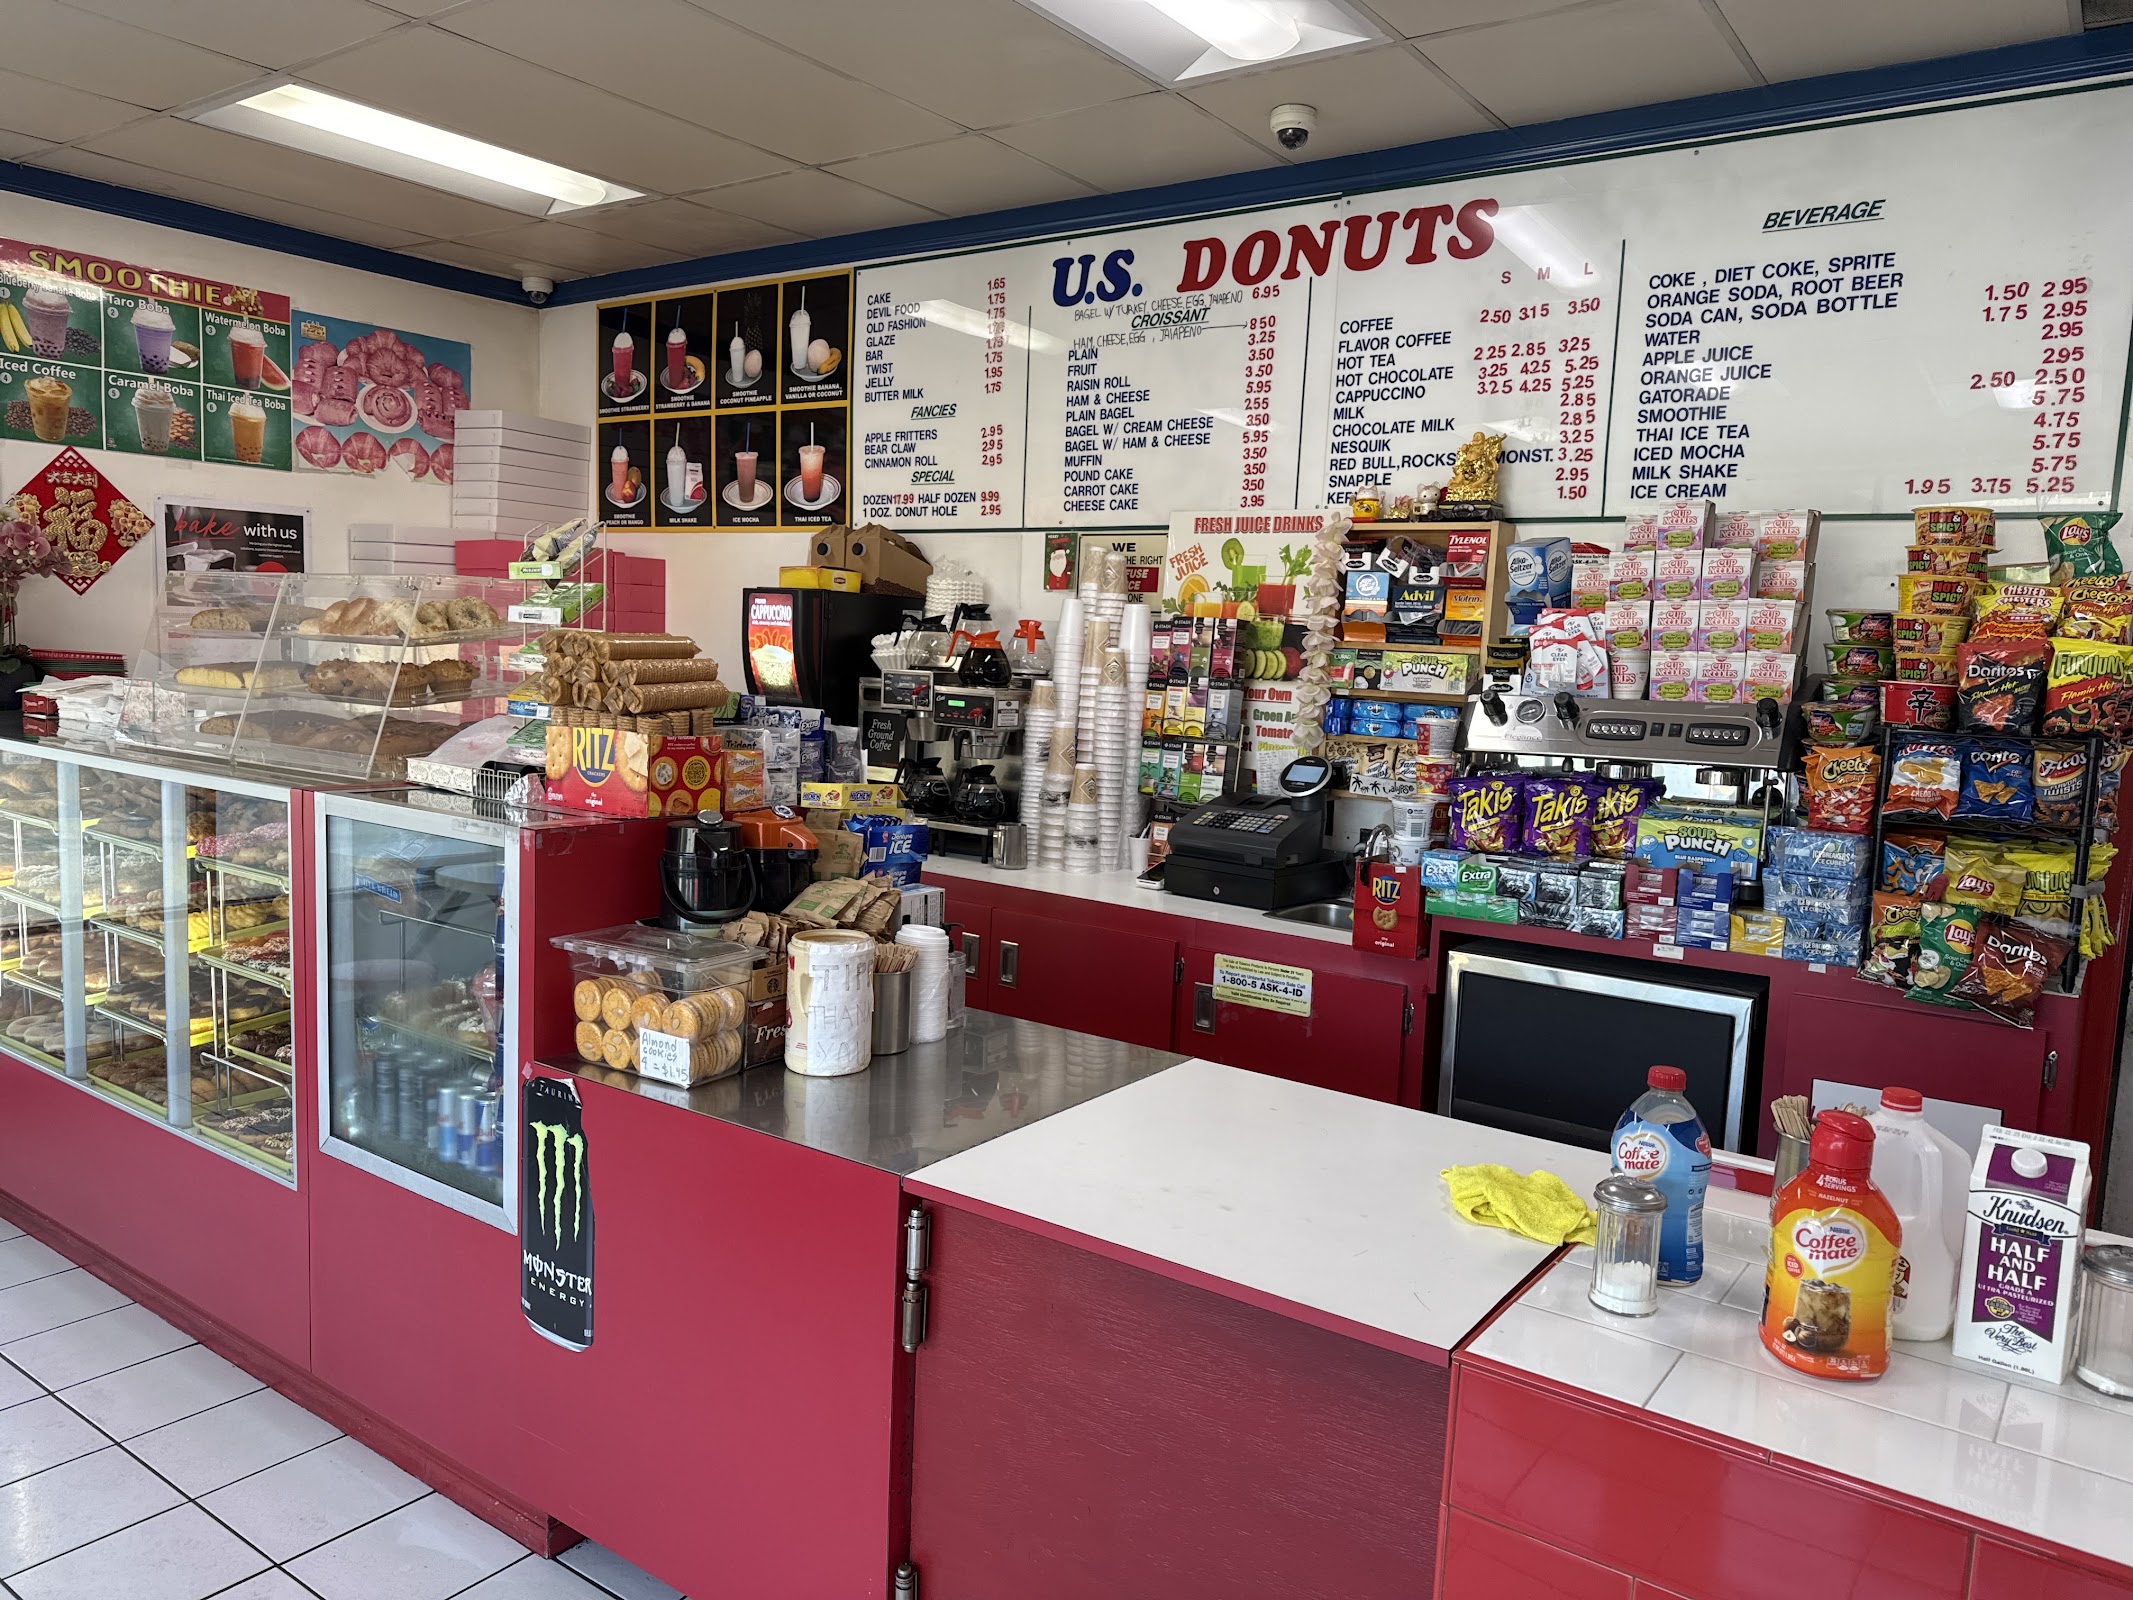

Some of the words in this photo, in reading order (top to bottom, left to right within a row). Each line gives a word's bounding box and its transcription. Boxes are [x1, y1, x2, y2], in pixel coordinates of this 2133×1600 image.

[1762, 200, 1885, 230] BEVERAGE
[1052, 250, 1142, 307] U.S.
[1176, 198, 1499, 292] DONUTS
[29, 250, 222, 306] SMOOTHIE
[1647, 288, 1720, 309] ORANGE
[1728, 284, 1782, 304] SODA,
[1791, 277, 1843, 297] ROOT
[1851, 271, 1904, 291] BEER
[107, 292, 134, 308] Taro
[138, 300, 170, 314] Boba
[868, 293, 891, 305] CAKE
[867, 306, 891, 319] DEVIL
[895, 303, 920, 315] FOOD
[1131, 308, 1210, 328] CROISSANT
[205, 312, 260, 332] Watermelon
[264, 322, 286, 336] Boba
[1340, 317, 1393, 334] COFFEE
[867, 335, 895, 347] GLAZE
[1645, 329, 1700, 347] WATER
[2041, 321, 2083, 340] 2.95
[1068, 349, 1098, 361] PLAIN
[1338, 357, 1364, 370] HOT
[1370, 354, 1395, 368] TEA
[1642, 348, 1695, 366] APPLE
[1701, 345, 1753, 363] JUICE
[0, 358, 28, 373] Iced
[32, 362, 76, 380] Coffee
[866, 363, 893, 375] TWIST
[1068, 363, 1097, 376] FRUIT
[1336, 374, 1362, 388] HOT
[1368, 366, 1454, 384] CHOCOLATE
[108, 375, 160, 391] Caramel
[164, 382, 194, 397] Boba
[865, 376, 894, 388] JELLY
[1067, 378, 1100, 391] RAISIN
[1104, 376, 1130, 389] ROLL
[206, 389, 226, 402] Thai
[228, 392, 245, 404] Iced
[246, 395, 262, 407] Tea
[264, 398, 286, 410] Boba
[785, 391, 807, 400] VANILLA
[865, 390, 899, 402] BUTTER
[903, 387, 923, 399] MILK
[1067, 394, 1089, 407] HAM
[1094, 393, 1101, 405] &
[1107, 390, 1150, 404] CHEESE
[1336, 387, 1425, 404] CAPPUCCINO
[1639, 385, 1730, 404] GATORADE
[911, 404, 957, 418] FANCIES
[1637, 405, 1727, 423] SMOOTHIE
[2034, 411, 2079, 428] 4.75
[1066, 424, 1098, 437] BAGEL
[1104, 423, 1118, 435] W/
[1123, 420, 1162, 434] CREAM
[1168, 416, 1213, 430] CHEESE
[1332, 420, 1415, 437] CHOCOLATE
[1421, 418, 1455, 432] MILK
[865, 433, 891, 443] APPLE
[895, 429, 937, 441] FRITTERS
[1637, 427, 1673, 442] THAI
[1680, 425, 1709, 440] ICE
[1717, 423, 1750, 439] TEA
[2033, 432, 2080, 450] 5.75
[1331, 439, 1391, 454] NESQUIK
[865, 457, 911, 468] CINNAMON
[915, 456, 937, 466] ROLL
[46, 471, 98, 488] 大吉大利
[911, 471, 955, 483] SPECIAL
[1065, 470, 1100, 481] POUND
[1105, 469, 1133, 480] CAKE
[1329, 473, 1391, 488] SNAPPLE
[1555, 468, 1589, 481] 2.95
[1632, 465, 1672, 480] MILK
[1679, 463, 1737, 479] SHAKE
[1630, 484, 1658, 499] ICE
[1664, 482, 1727, 499] CREAM
[1972, 477, 2012, 494] 3.75
[896, 507, 928, 517] DONUT
[932, 506, 957, 516] HOLE
[981, 505, 1001, 516] 2.95
[1064, 500, 1105, 511] CHEESE
[1110, 499, 1139, 510] CAKE
[1240, 495, 1264, 508] 3.95
[1663, 516, 1697, 525] NOODLES
[1671, 510, 1691, 518] CUP
[172, 508, 240, 537] bake
[244, 524, 277, 539] with
[280, 527, 297, 540] us
[1194, 518, 1233, 534] FRESH
[1234, 516, 1270, 533] JUICE
[1272, 516, 1324, 532] DRINKS
[1112, 542, 1136, 552] WE
[1449, 535, 1487, 545] TYLENOL
[1140, 556, 1163, 565] RIGHT
[1169, 543, 1204, 568] FRESH
[1510, 562, 1532, 572] Seltzer
[1934, 581, 1956, 592] HOT
[1400, 590, 1435, 602] Advil
[1452, 594, 1480, 603] Motrin
[1932, 592, 1961, 603] SPICY
[750, 604, 793, 622] CAPPUCCINO
[1411, 656, 1439, 665] SOUR
[2054, 651, 2125, 679] FUNYUNS
[1402, 664, 1448, 678] PUNCH
[1969, 665, 2024, 678] Doritos
[1268, 689, 1292, 701] Own
[871, 718, 892, 731] Fresh
[868, 729, 894, 743] Ground
[572, 727, 616, 772] RITZ
[869, 739, 892, 752] Coffee
[731, 757, 757, 768] Trident
[585, 798, 603, 807] original
[1458, 783, 1513, 826] Takis
[1532, 786, 1588, 828] Takis
[1678, 826, 1717, 838] SOUR
[889, 841, 912, 854] ICE
[1664, 835, 1732, 857] PUNCH
[1461, 869, 1492, 883] Extra
[1372, 877, 1400, 900] RITZ
[1987, 935, 2048, 965] Doritos
[1222, 975, 1257, 989] 1-800-5
[1260, 983, 1303, 997] ASK-4-ID
[642, 1032, 676, 1051] Almond
[643, 1045, 677, 1062] cookies
[1618, 1141, 1659, 1160] Coffee
[1624, 1160, 1660, 1170] mate
[1818, 1193, 1848, 1204] HAZELNUT
[1983, 1196, 2065, 1235] Knudsen
[1796, 1228, 1856, 1248] Coffee
[1808, 1246, 1858, 1260] mate
[1990, 1236, 2050, 1263] HALF
[523, 1249, 592, 1295] MONSTER
[2000, 1256, 2036, 1272] AND
[1987, 1264, 2047, 1291] HALF
[530, 1278, 585, 1308] ENERGY
